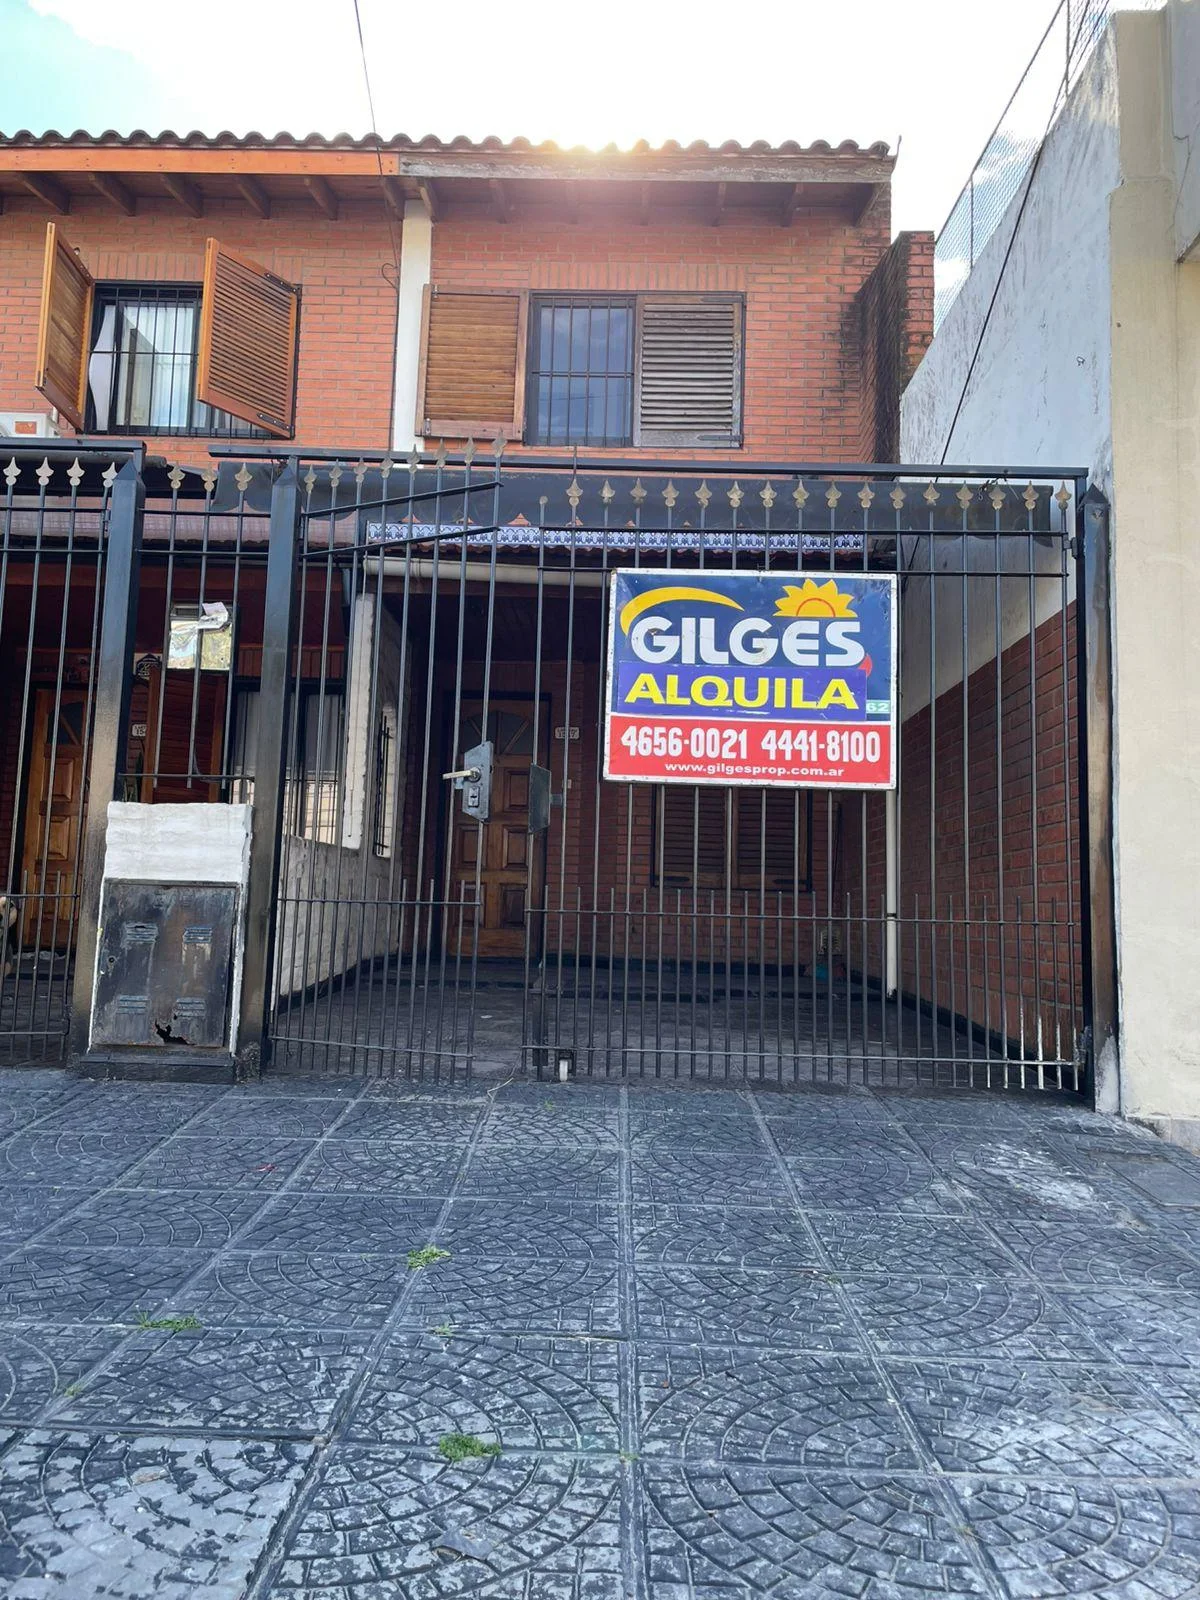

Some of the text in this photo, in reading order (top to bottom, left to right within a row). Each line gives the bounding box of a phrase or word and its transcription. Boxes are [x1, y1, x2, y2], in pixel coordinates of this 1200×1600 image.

[631, 616, 865, 666] GILGES
[624, 673, 859, 710] ALQUILA
[621, 725, 881, 762] 4656-0021 4441-8100
[665, 762, 844, 776] www.gilgesprop.com.ar
